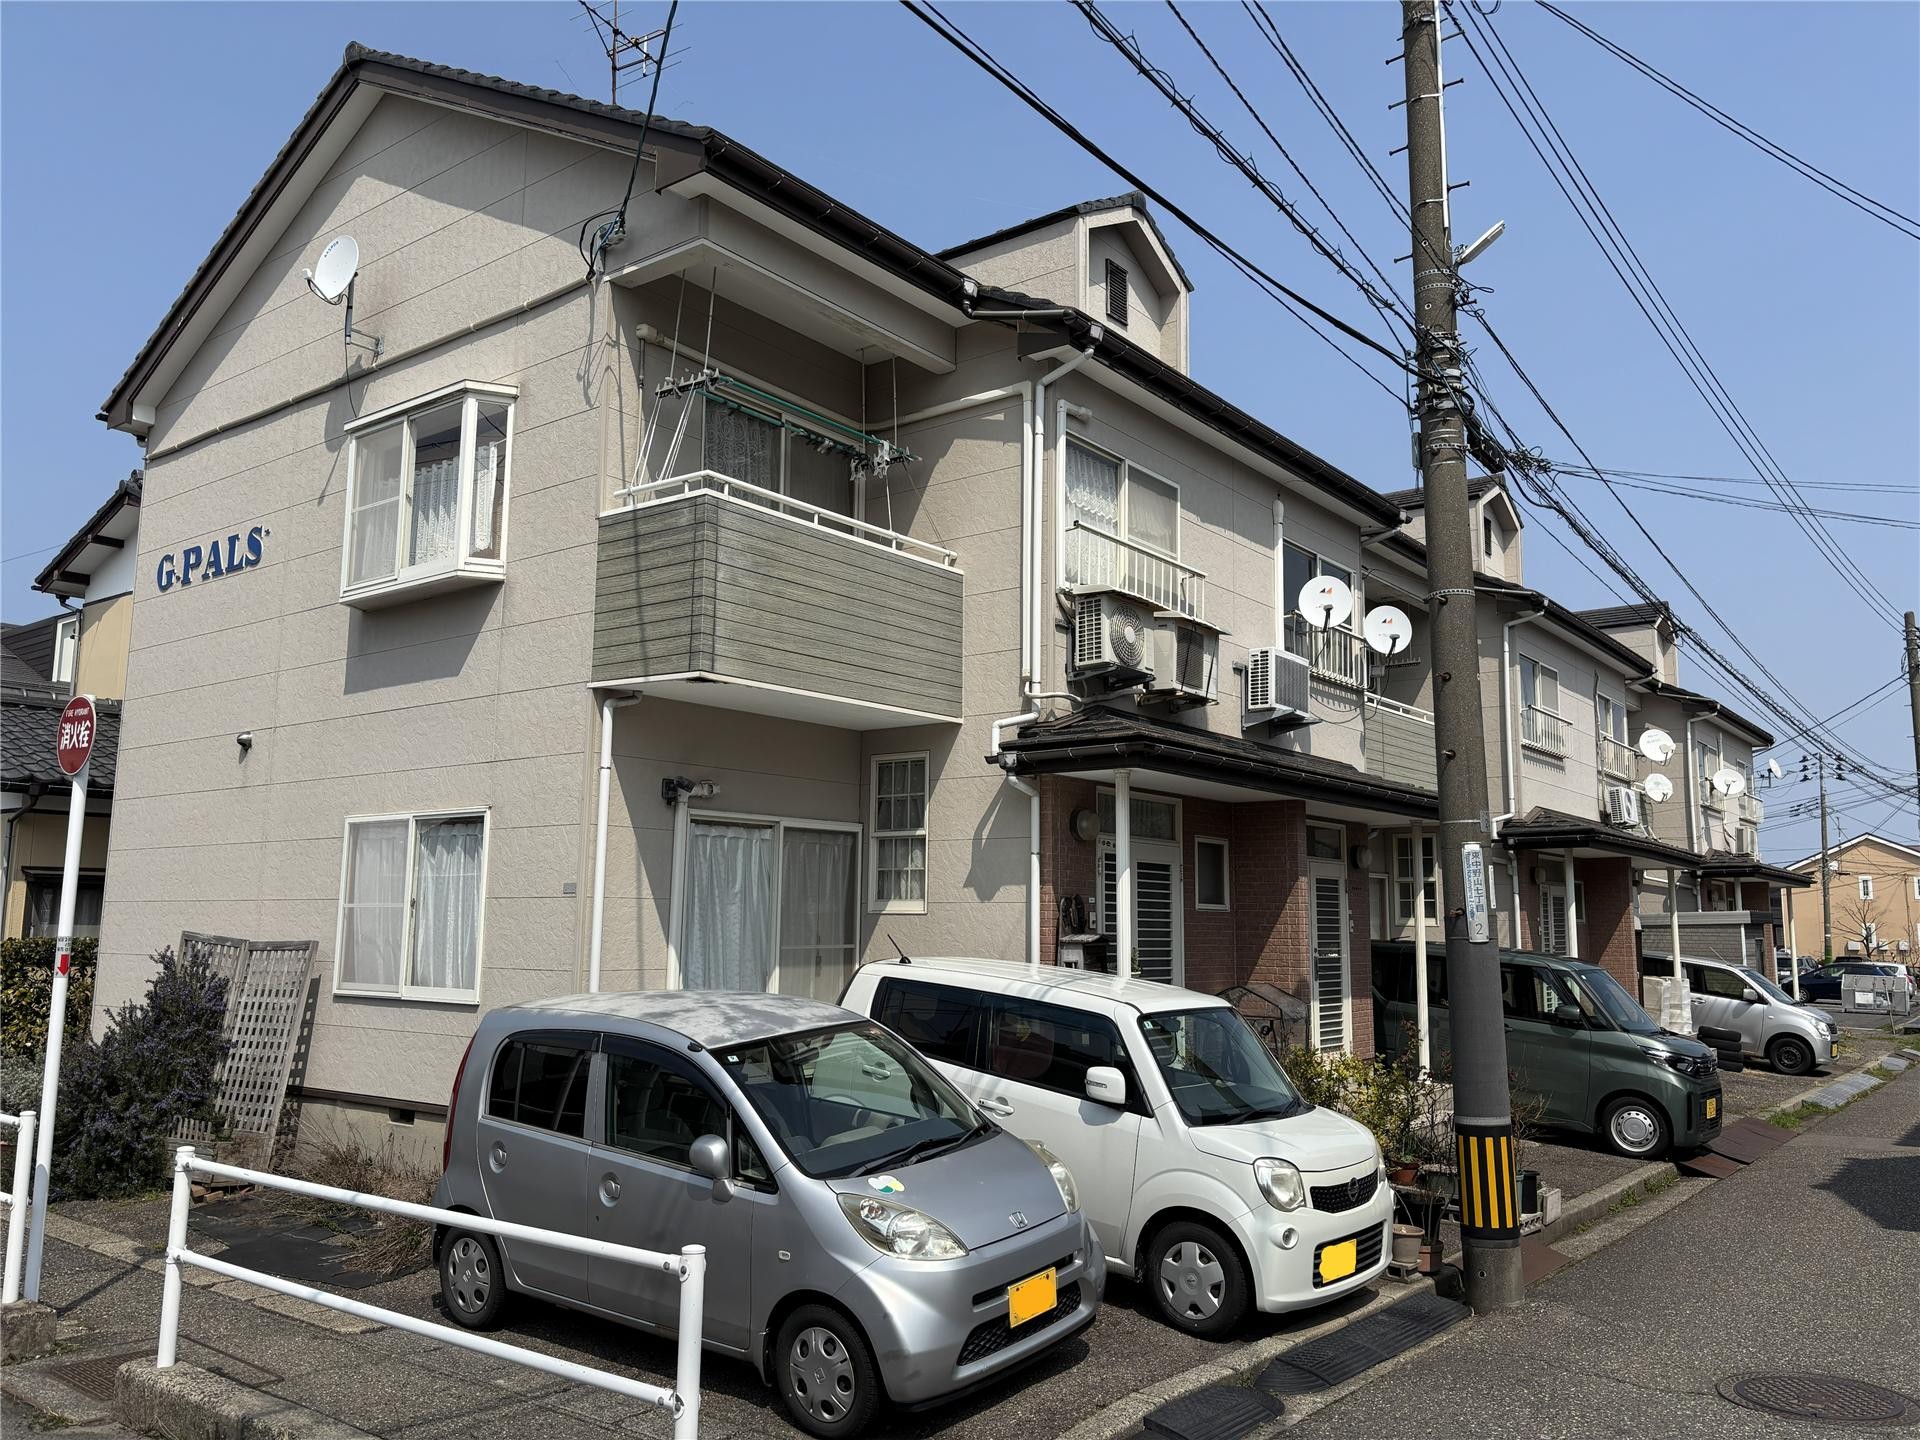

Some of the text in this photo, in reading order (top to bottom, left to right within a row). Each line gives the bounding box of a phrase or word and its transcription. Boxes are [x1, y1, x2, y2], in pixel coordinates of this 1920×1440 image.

[60, 720, 91, 750] 消火栓
[1471, 851, 1484, 912] 東中野山七丁目
[1475, 923, 1483, 935] 2
